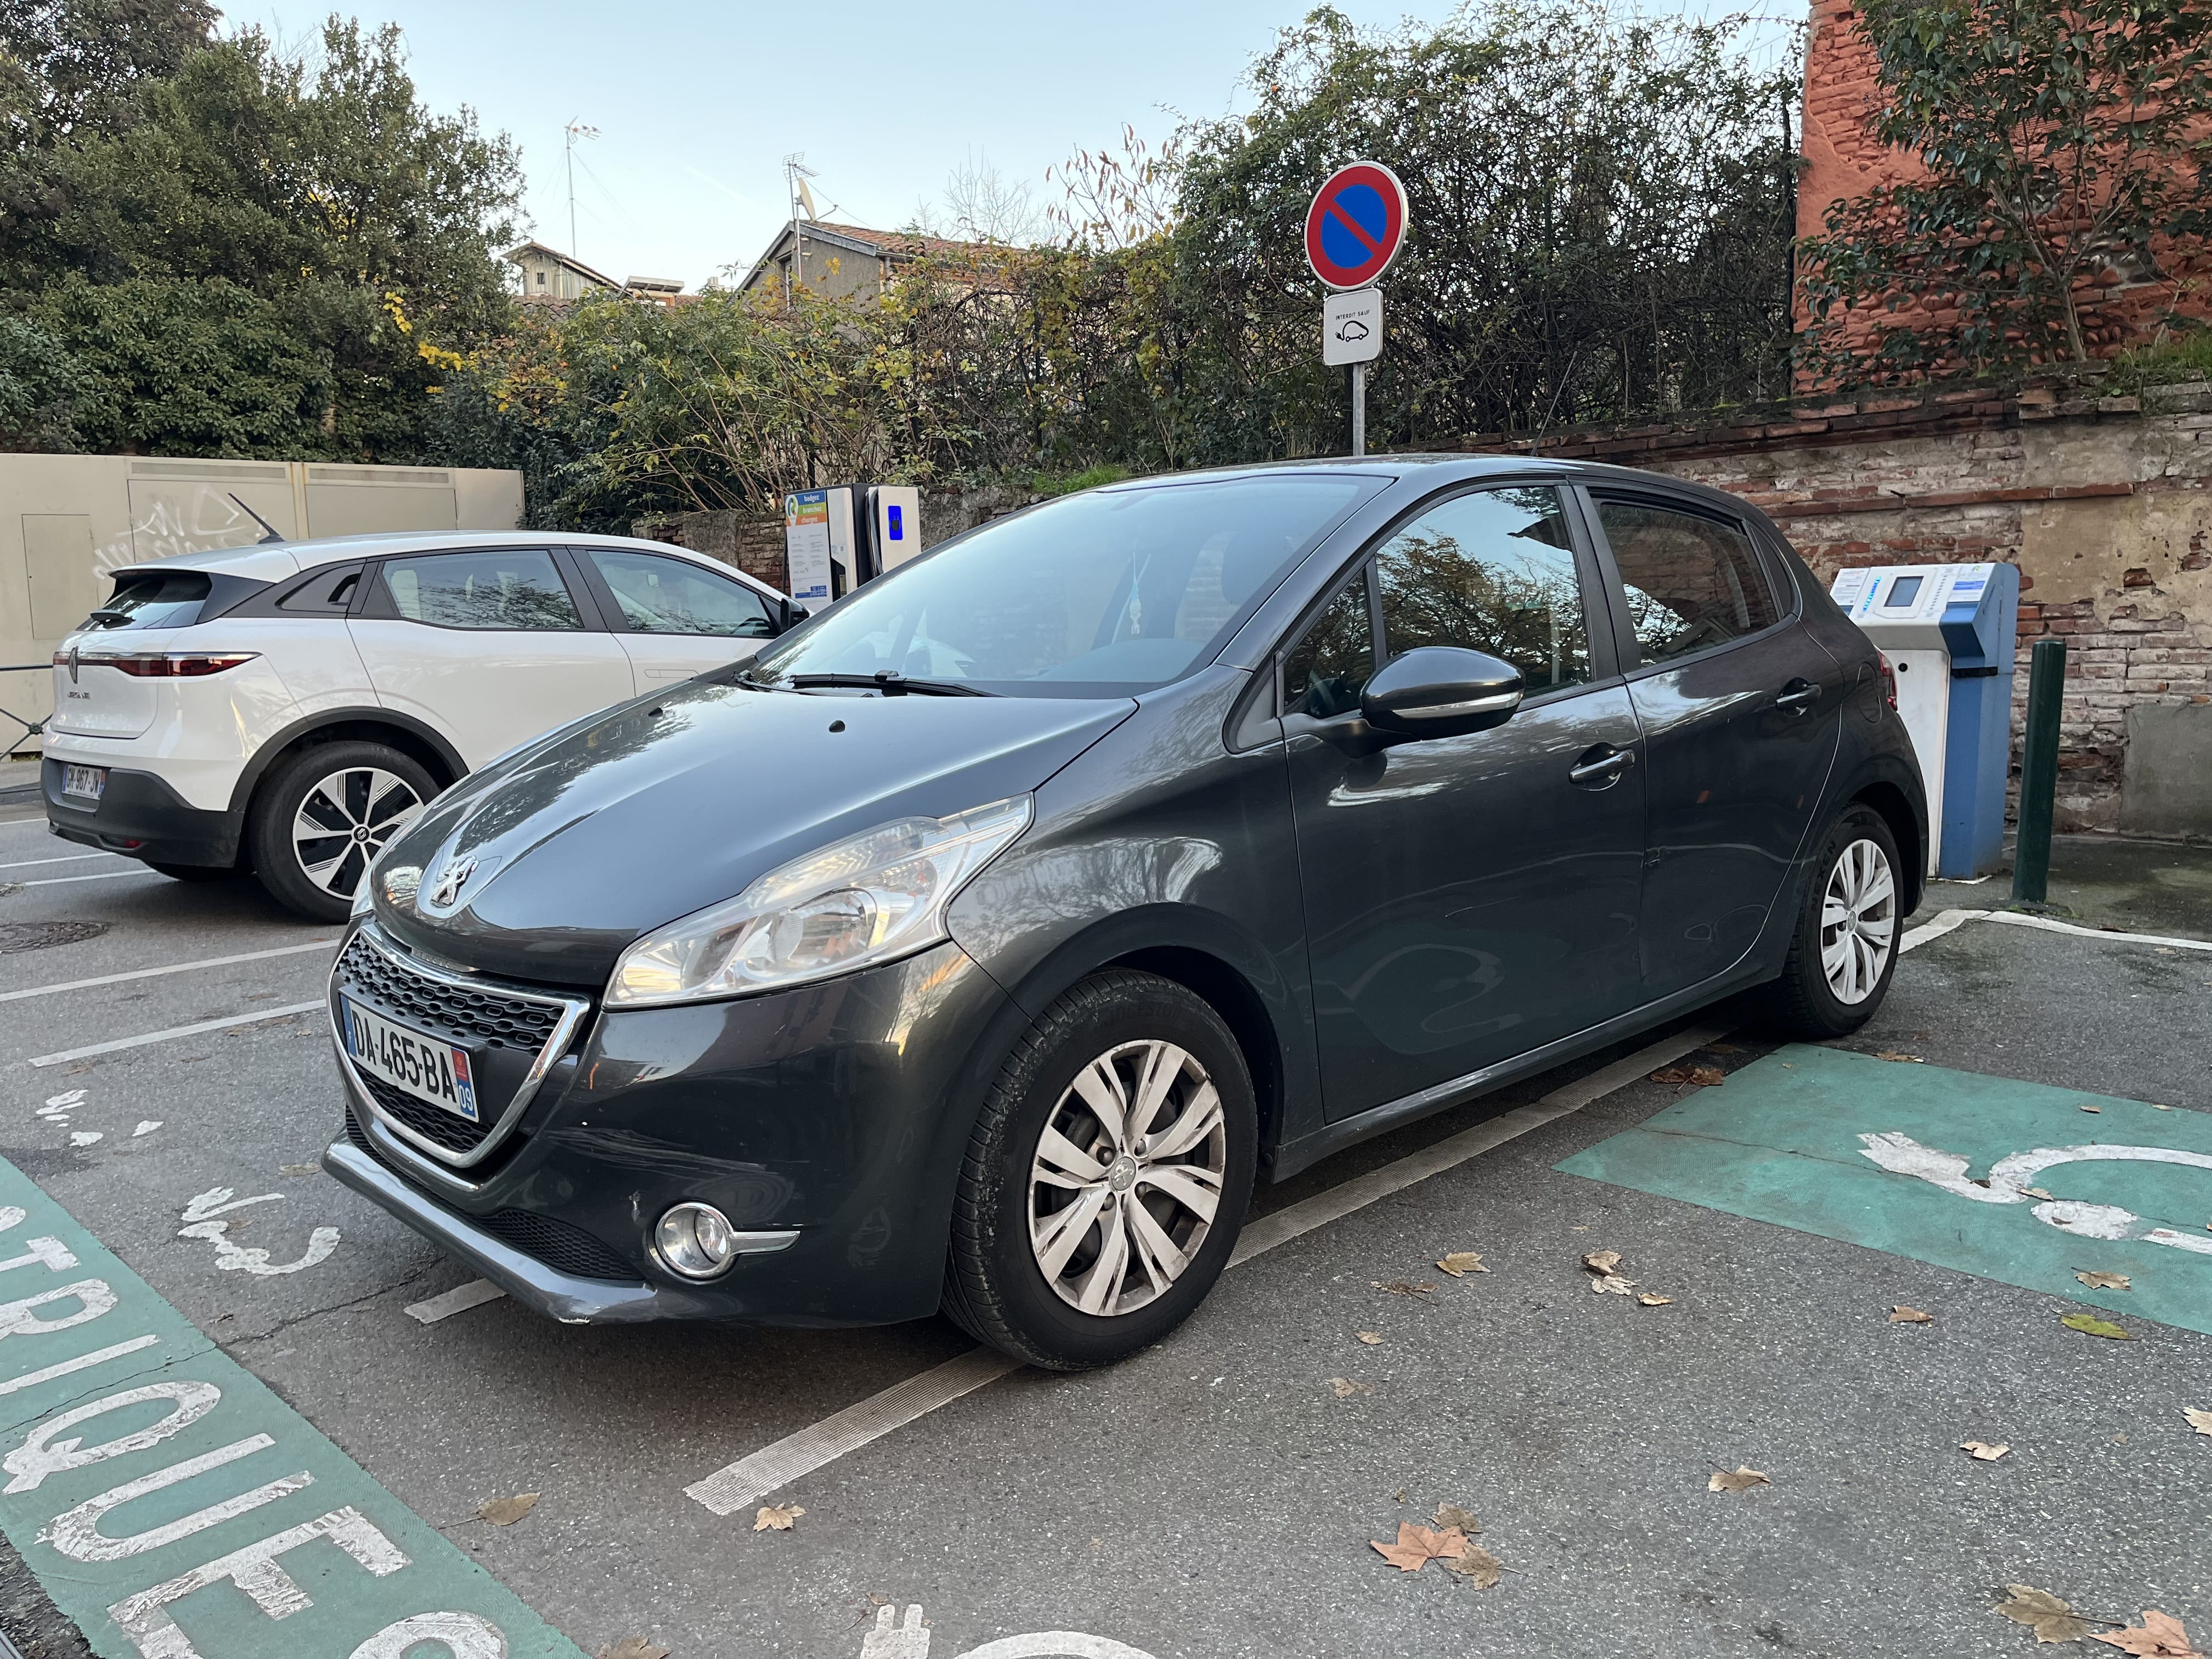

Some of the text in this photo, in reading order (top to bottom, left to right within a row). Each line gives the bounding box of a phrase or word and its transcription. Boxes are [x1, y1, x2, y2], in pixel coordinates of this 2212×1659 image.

[803, 505, 822, 514] branchez
[804, 494, 820, 503] badgez
[1812, 839, 1837, 910] NEXEN
[352, 1009, 457, 1103] DA-465-BA
[459, 1085, 473, 1111] 09
